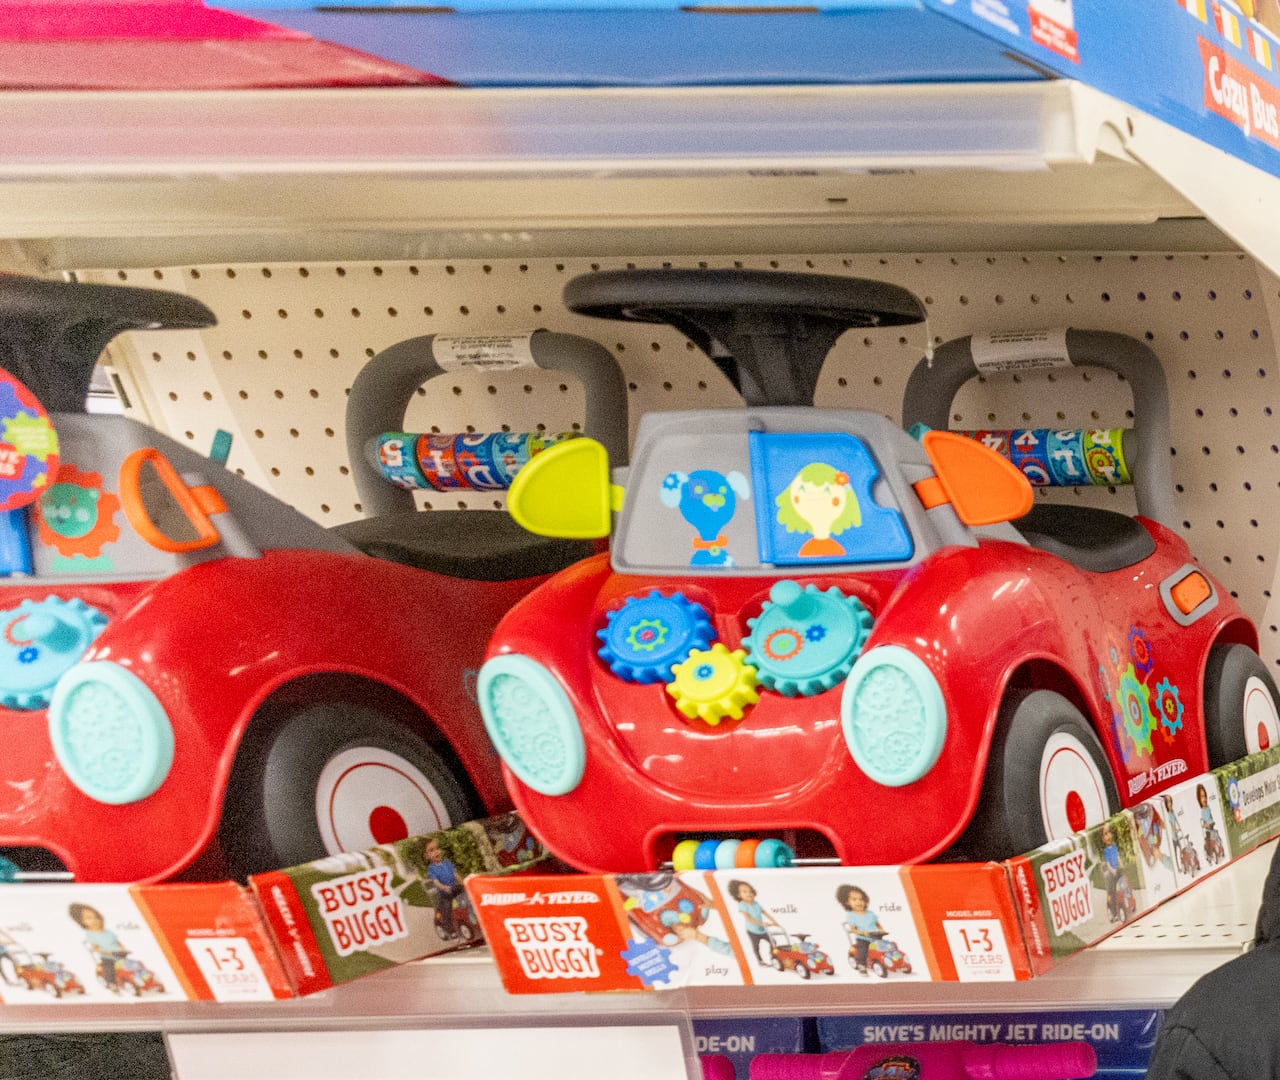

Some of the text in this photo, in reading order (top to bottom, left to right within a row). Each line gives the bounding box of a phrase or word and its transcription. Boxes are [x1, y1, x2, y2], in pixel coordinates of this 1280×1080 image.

[1208, 55, 1279, 137] Cozy Bus
[1044, 853, 1085, 894] BUSY
[318, 871, 392, 913] BUSY
[770, 903, 799, 915] walk
[878, 903, 903, 913] ride
[1051, 883, 1092, 931] BUGGY
[332, 902, 403, 951] BUGGY
[509, 921, 583, 943] BUSY
[958, 928, 993, 953] 1-3
[204, 945, 245, 974] 1-3
[521, 948, 595, 973] BUGGY
[704, 965, 729, 977] play
[960, 953, 1004, 966] YEARS
[213, 973, 259, 986] YEARS
[864, 1022, 1120, 1043] SKYE'S MIGHTY JET RIDE-ON
